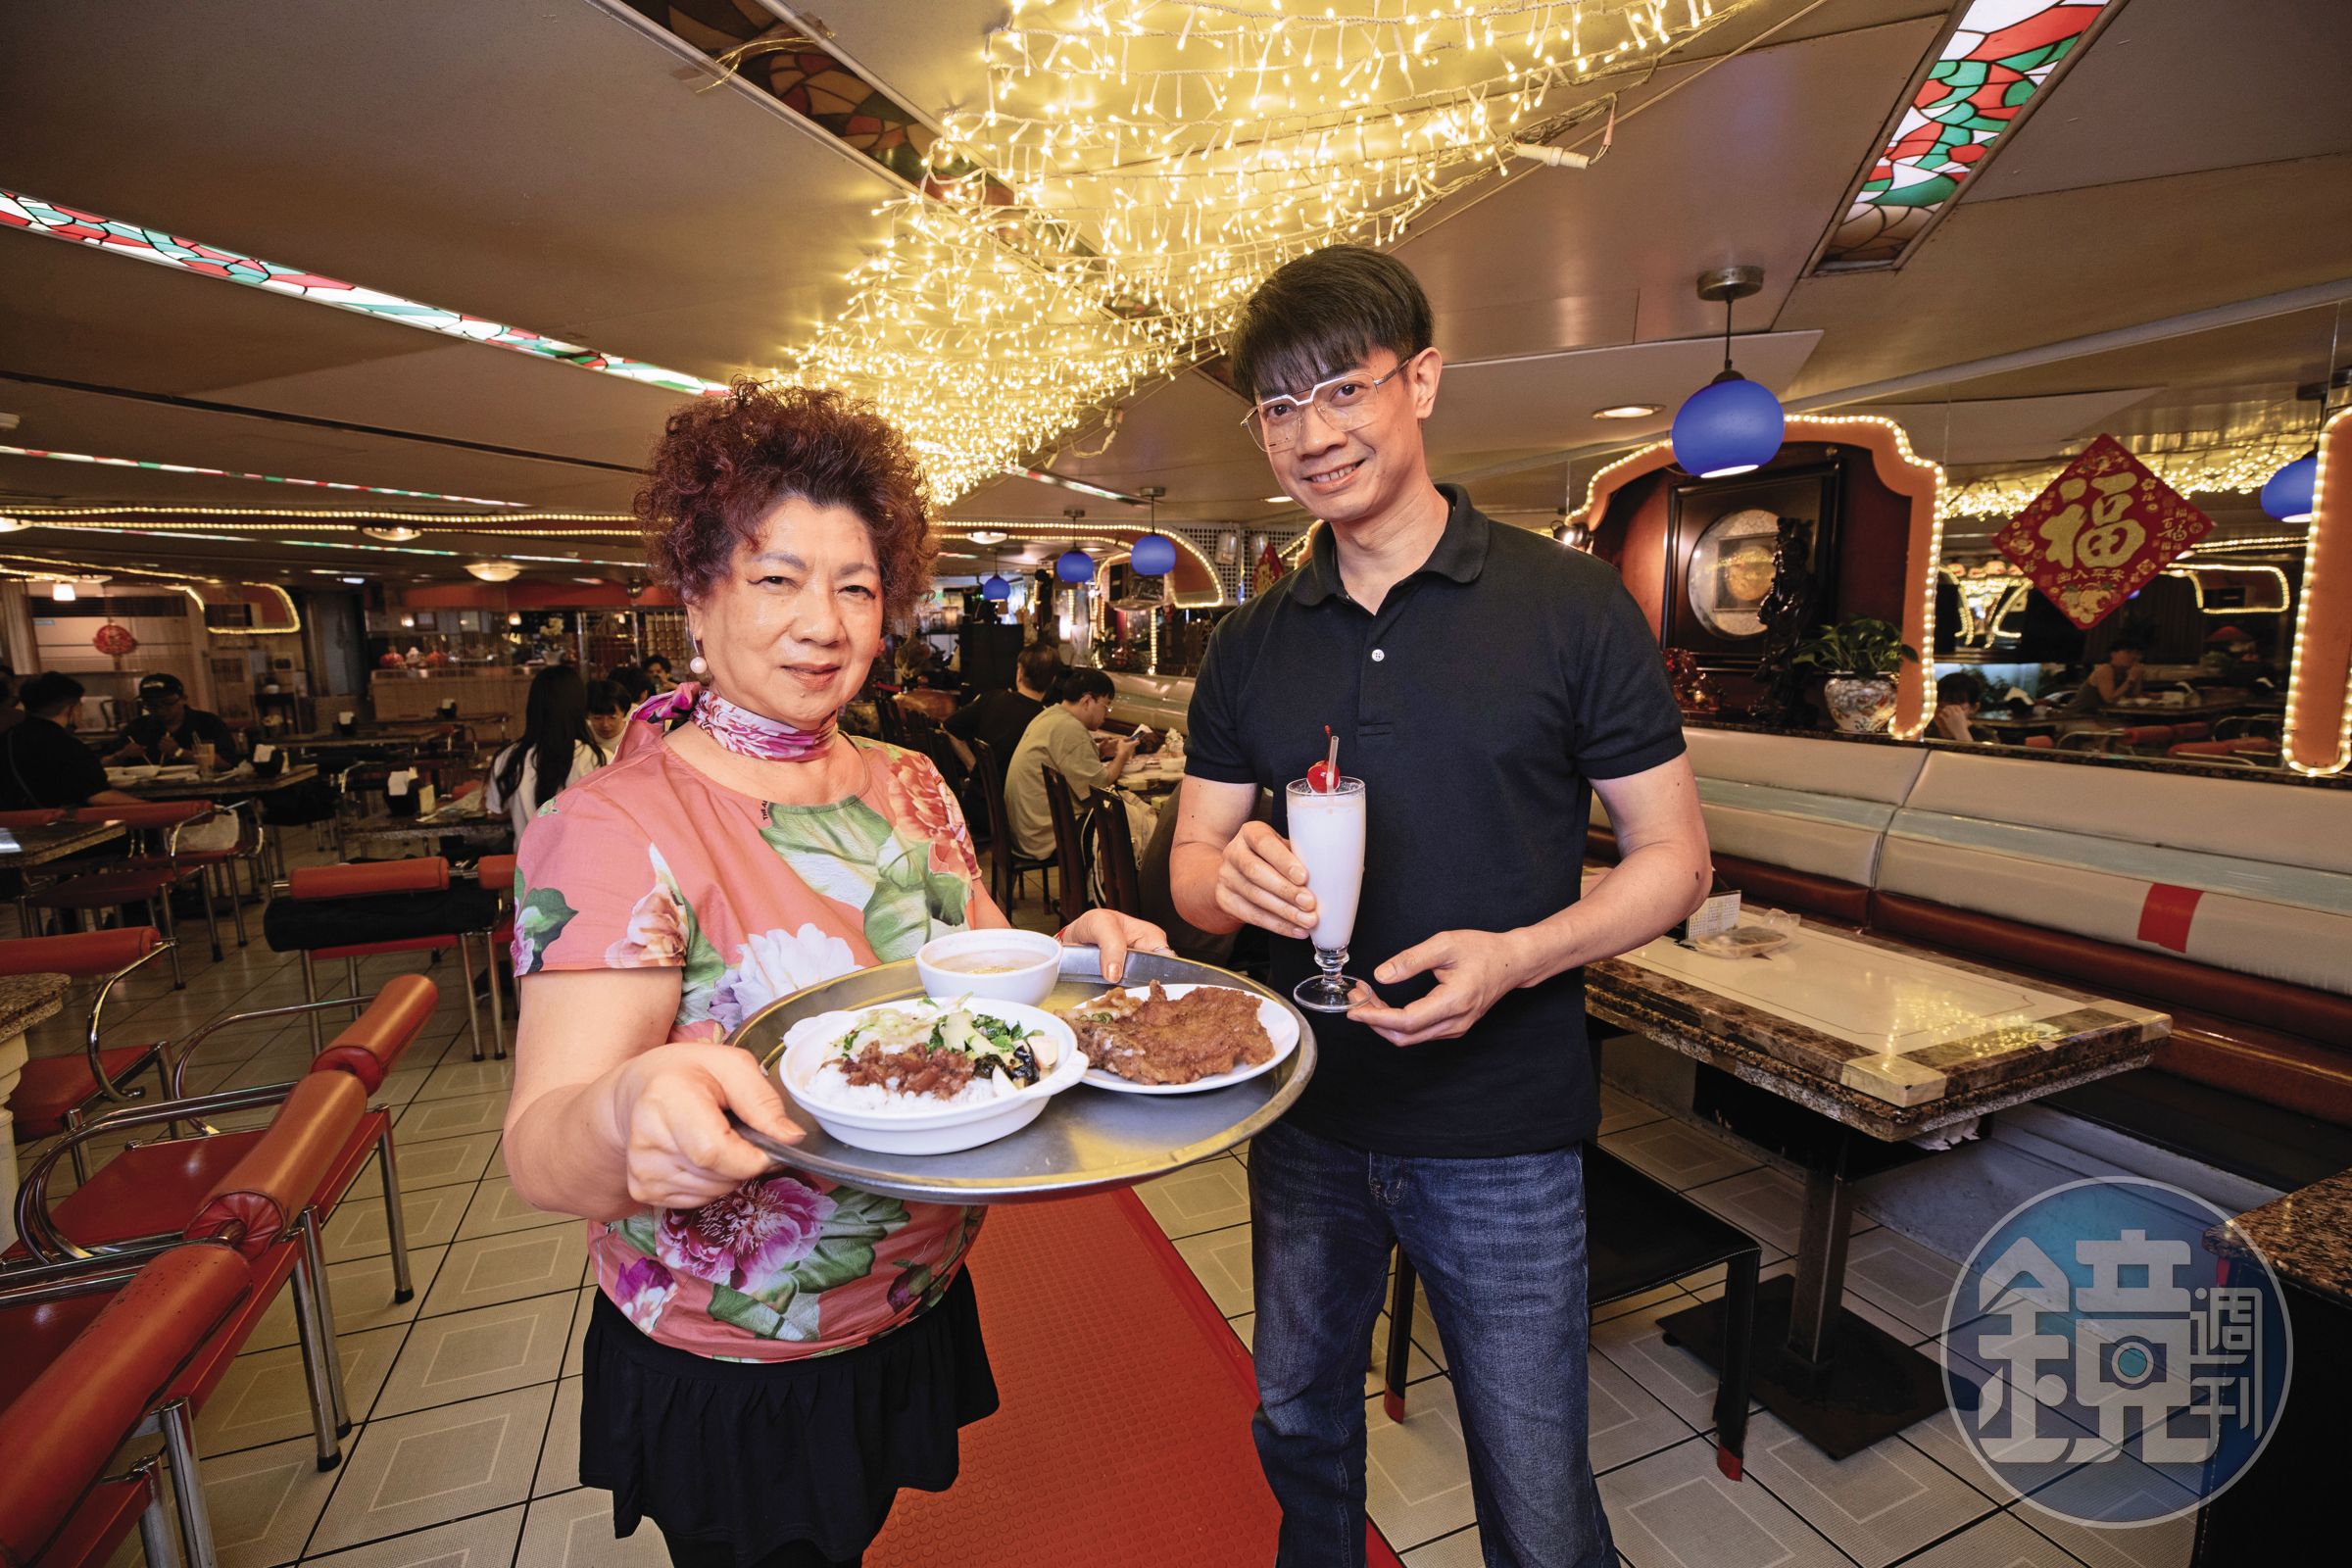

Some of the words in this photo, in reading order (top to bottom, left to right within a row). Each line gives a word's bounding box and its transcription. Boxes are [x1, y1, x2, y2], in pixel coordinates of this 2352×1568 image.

[2039, 471, 2146, 568] 福
[2057, 567, 2125, 584] 出入平安
